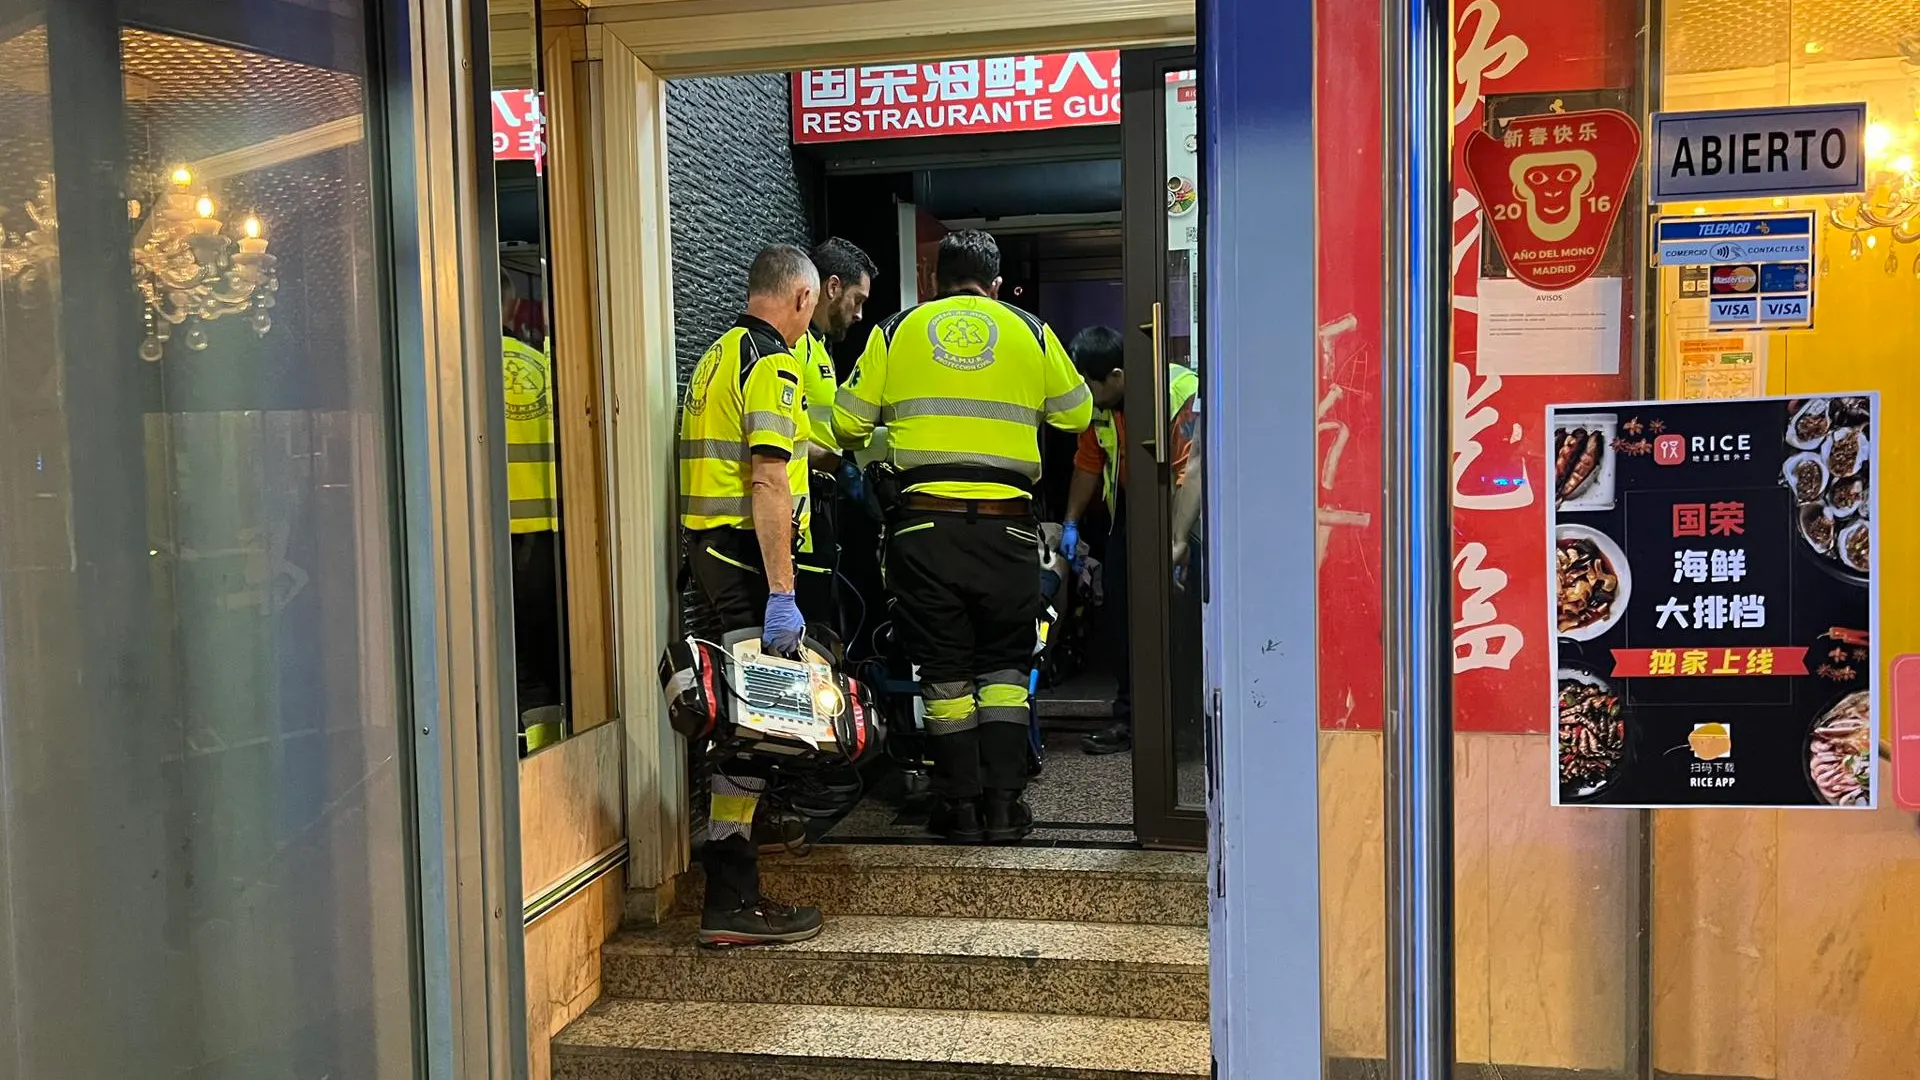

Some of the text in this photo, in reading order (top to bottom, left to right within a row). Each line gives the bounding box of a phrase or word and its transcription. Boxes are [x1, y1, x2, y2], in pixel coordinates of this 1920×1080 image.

[802, 99, 1053, 134] RESTRAURANTE
[1504, 122, 1598, 148] 新春快乐
[1671, 128, 1847, 177] ABIERTO
[1494, 203, 1522, 221] 20
[1587, 195, 1611, 213] 16
[1699, 222, 1750, 236] TELEPAGO
[1513, 246, 1595, 261] AÑO DEL MONO
[1665, 245, 1806, 257] COMERCIO CONTACTLESS
[1532, 265, 1576, 276] MADRID
[1713, 274, 1757, 285] MasterCard
[1536, 294, 1563, 302] AVISOS
[1717, 304, 1750, 315] VISA
[1768, 303, 1802, 315] VISA
[1692, 435, 1750, 452] RICE
[1673, 501, 1745, 538] 国荣
[1673, 549, 1747, 583] 海鲜
[1656, 594, 1766, 629] 大排档
[1649, 648, 1774, 676] 独家上线
[1690, 777, 1736, 787] RICE APP
